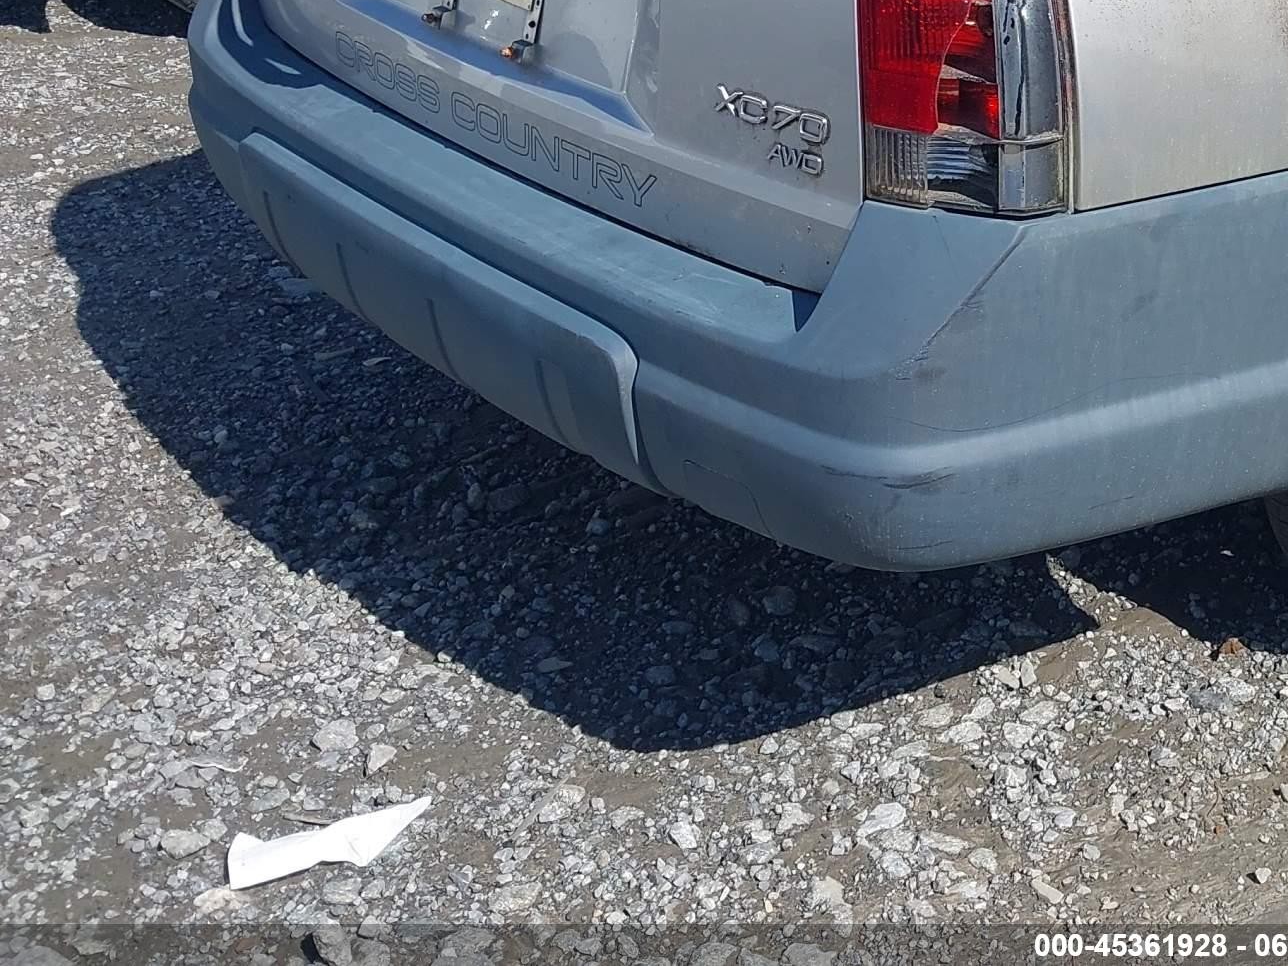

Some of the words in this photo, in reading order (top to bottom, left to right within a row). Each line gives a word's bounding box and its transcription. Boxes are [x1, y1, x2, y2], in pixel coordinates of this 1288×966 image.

[335, 30, 441, 114] CROSS
[450, 90, 658, 208] COUNTRY
[714, 83, 831, 145] XC70
[767, 142, 825, 176] AWD
